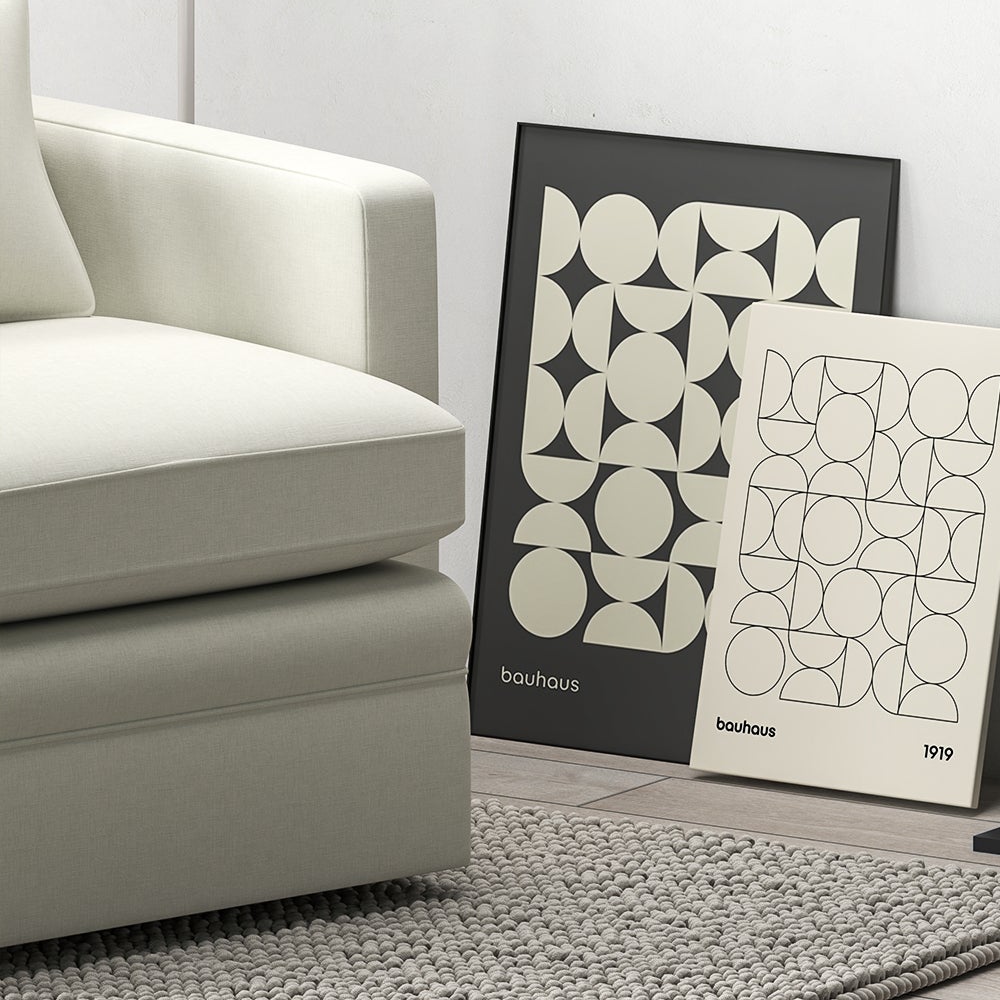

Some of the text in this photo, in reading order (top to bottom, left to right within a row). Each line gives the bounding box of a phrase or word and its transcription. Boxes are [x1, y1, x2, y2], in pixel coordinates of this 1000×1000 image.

[501, 665, 581, 693] bauhaus
[716, 716, 777, 738] bauhaus
[923, 744, 954, 762] 1919
